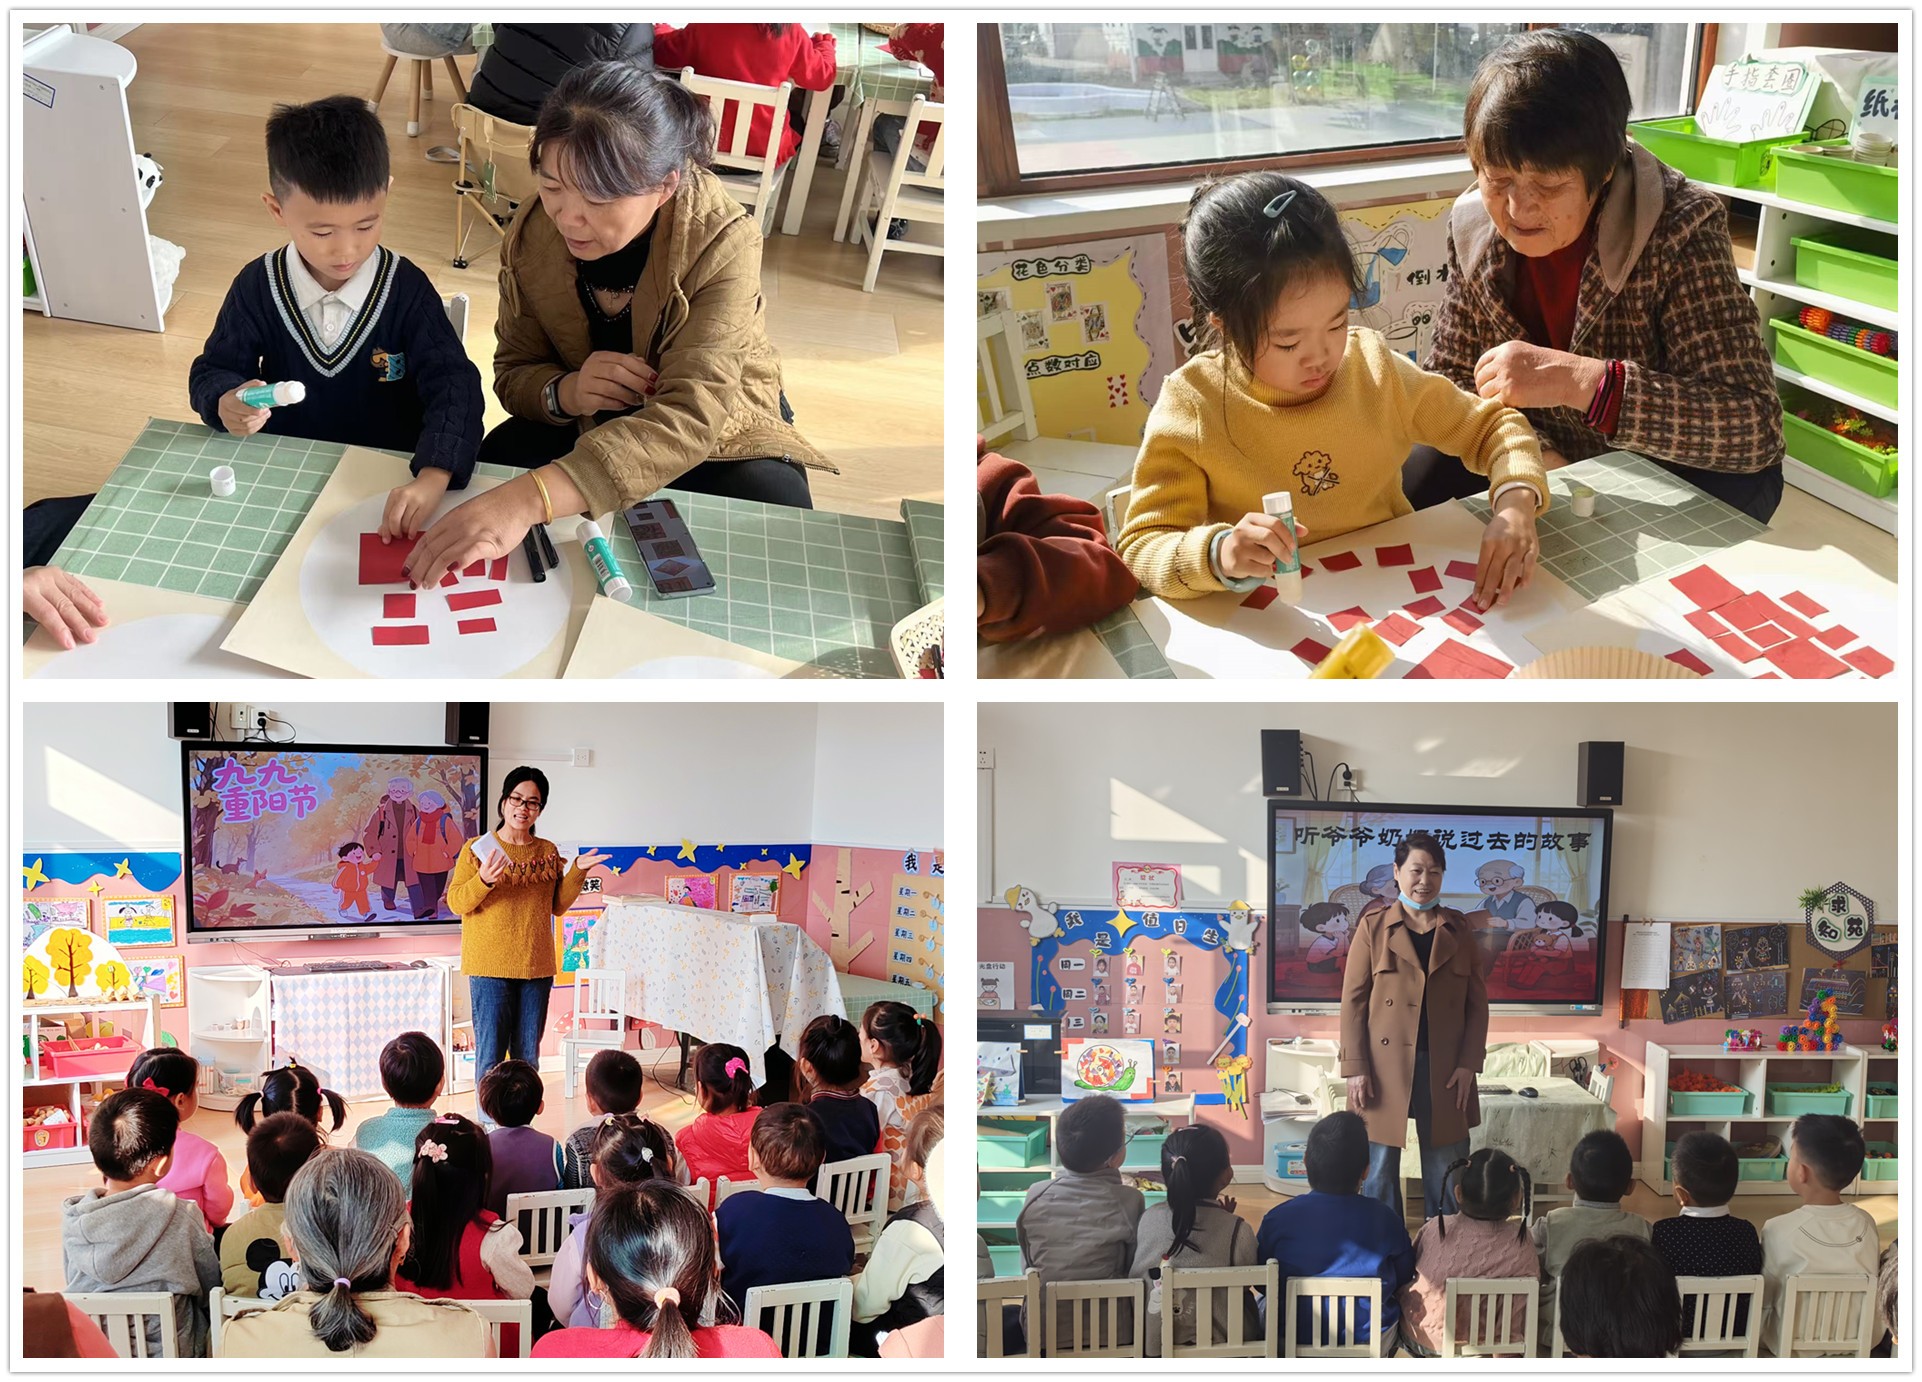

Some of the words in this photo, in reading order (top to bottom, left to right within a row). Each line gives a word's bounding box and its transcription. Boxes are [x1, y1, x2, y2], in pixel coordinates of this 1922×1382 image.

[1015, 258, 1089, 277] 花色分类
[1026, 353, 1099, 377] 点数对应
[214, 759, 299, 791] 九九
[219, 783, 318, 823] 重阳节
[1294, 825, 1592, 853] 听爷爷奶说过去的故事
[898, 887, 917, 897] 星期一
[896, 906, 915, 917] 星期二
[894, 928, 913, 940] 星期三
[893, 951, 912, 963] 星期四
[1061, 959, 1084, 970] 周一
[891, 974, 911, 987] 星期五
[1063, 989, 1086, 999] 周二
[1067, 1017, 1084, 1027] 三
